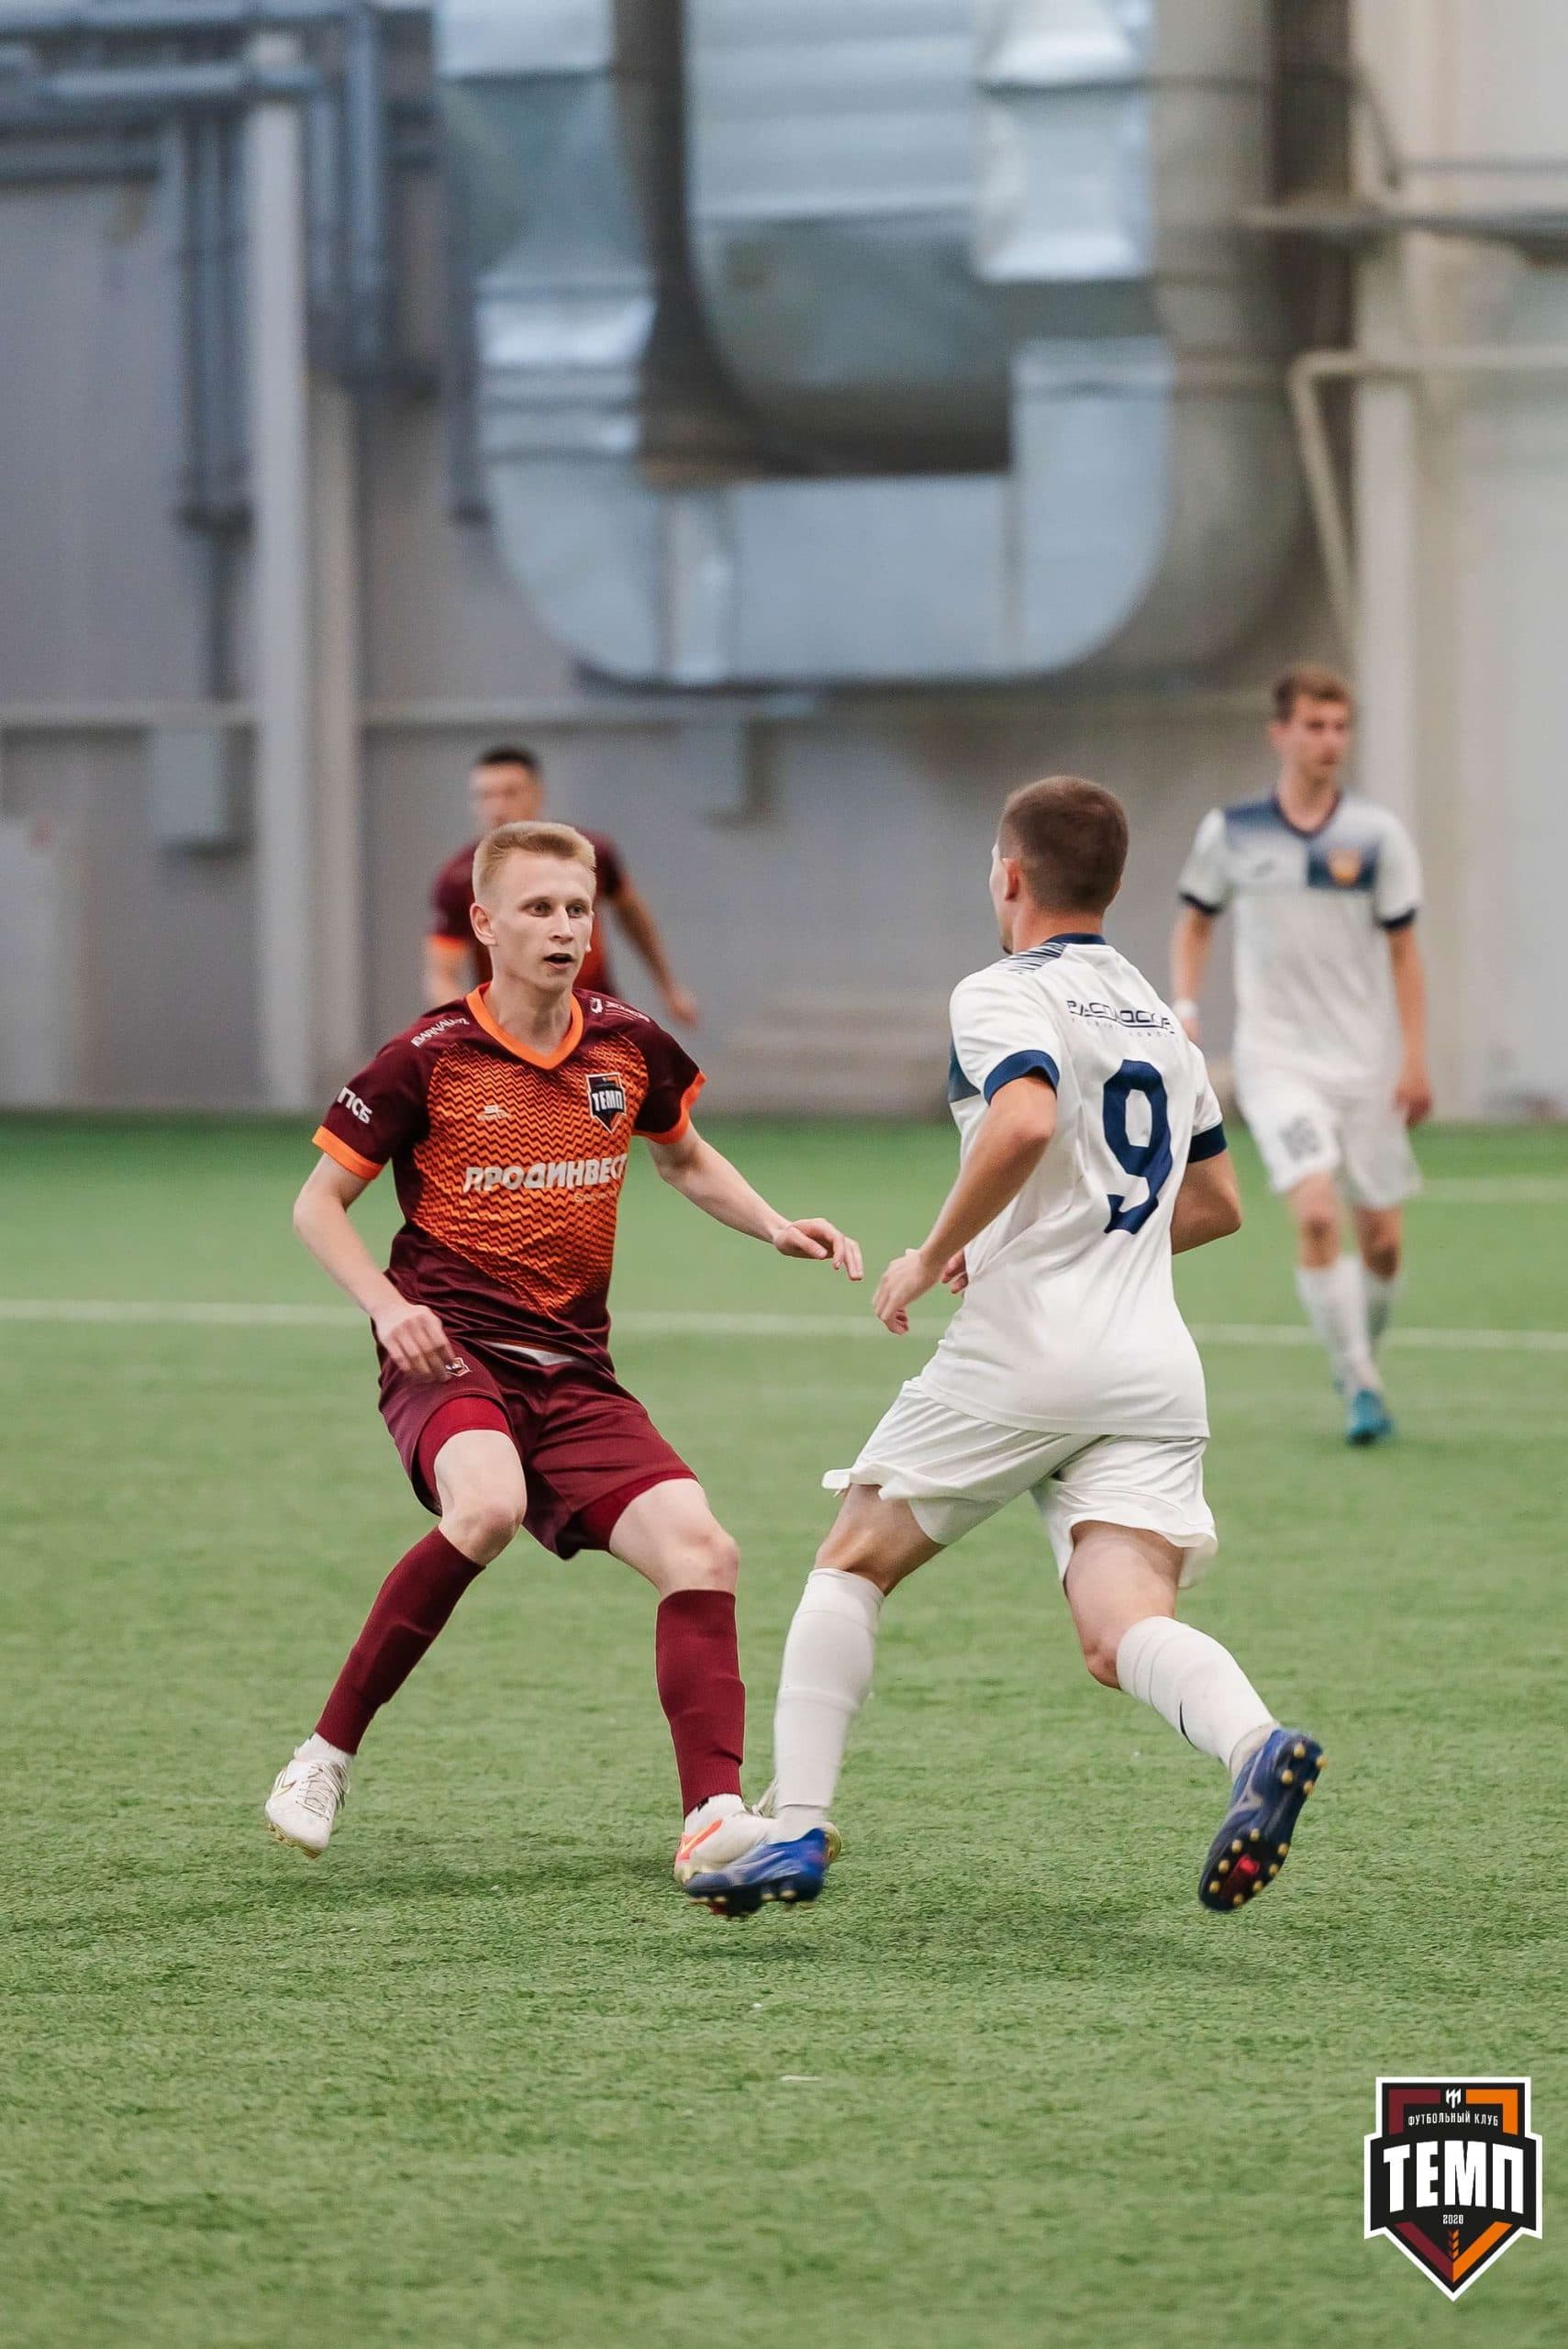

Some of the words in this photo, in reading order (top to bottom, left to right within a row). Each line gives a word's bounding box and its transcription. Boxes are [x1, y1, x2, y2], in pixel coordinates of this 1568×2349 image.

[337, 1085, 373, 1124] ПСБ
[591, 1089, 624, 1112] ТЕМП
[1103, 1059, 1173, 1235] 9
